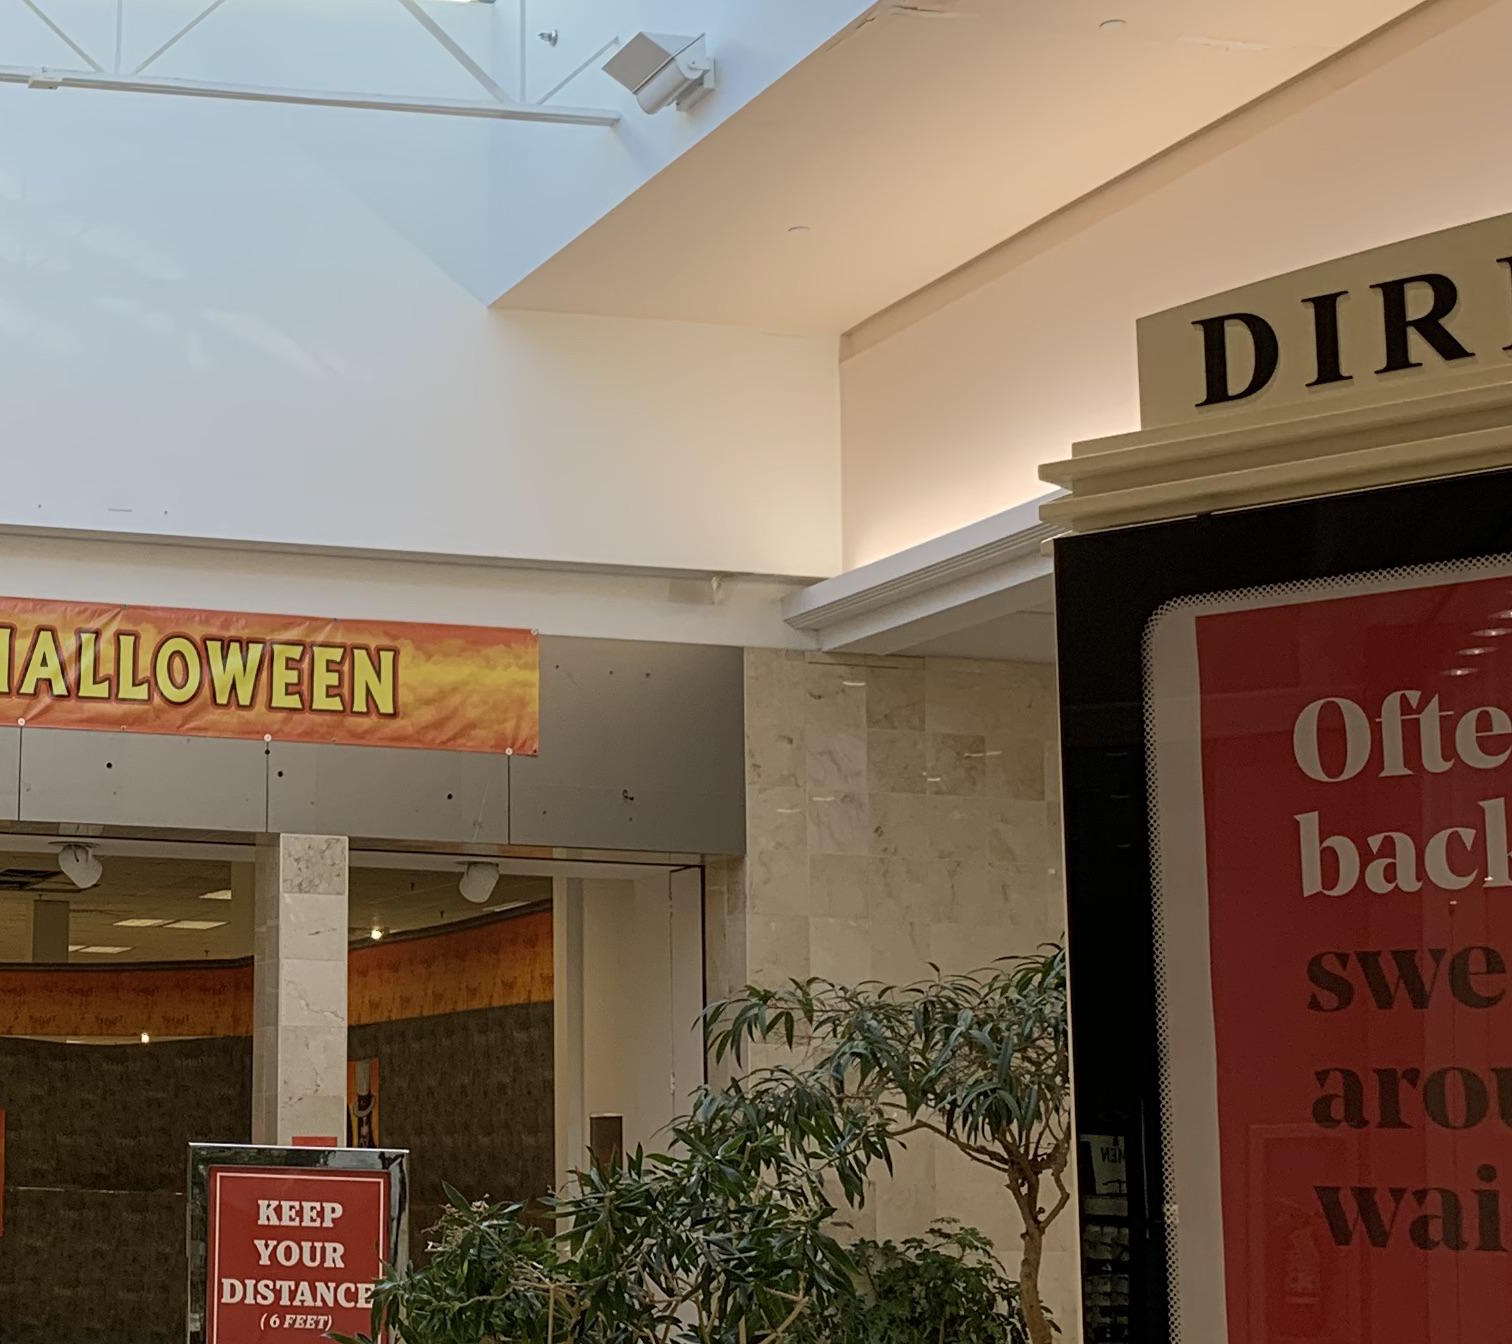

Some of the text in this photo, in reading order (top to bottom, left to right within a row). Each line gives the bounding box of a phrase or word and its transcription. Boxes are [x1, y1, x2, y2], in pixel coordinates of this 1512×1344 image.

[1192, 256, 1512, 408] DIR
[1293, 689, 1512, 783] Ofte
[1306, 945, 1507, 1013] swe
[257, 1199, 343, 1228] KEEP
[1314, 1164, 1508, 1253] wai
[254, 1239, 345, 1269] YOUR
[221, 1278, 375, 1309] DISTANCE
[283, 1314, 333, 1332] FEET)
